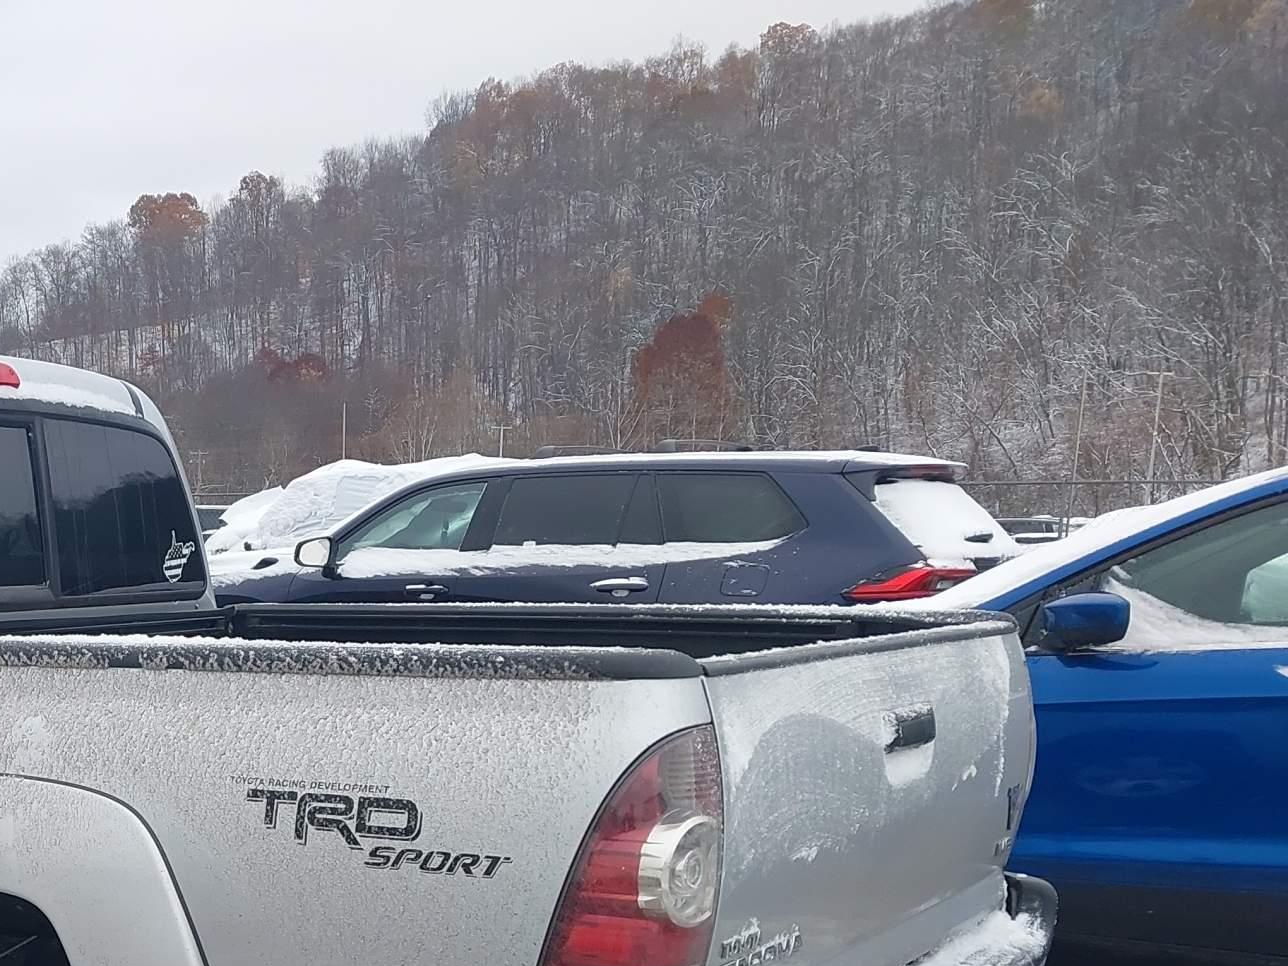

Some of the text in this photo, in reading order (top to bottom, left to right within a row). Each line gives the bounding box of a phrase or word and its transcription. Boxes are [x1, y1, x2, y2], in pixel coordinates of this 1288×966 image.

[229, 774, 390, 794] TOYOTA RACING DEVELOPMENT
[246, 787, 424, 850] TRD
[363, 845, 513, 879] SPORT
